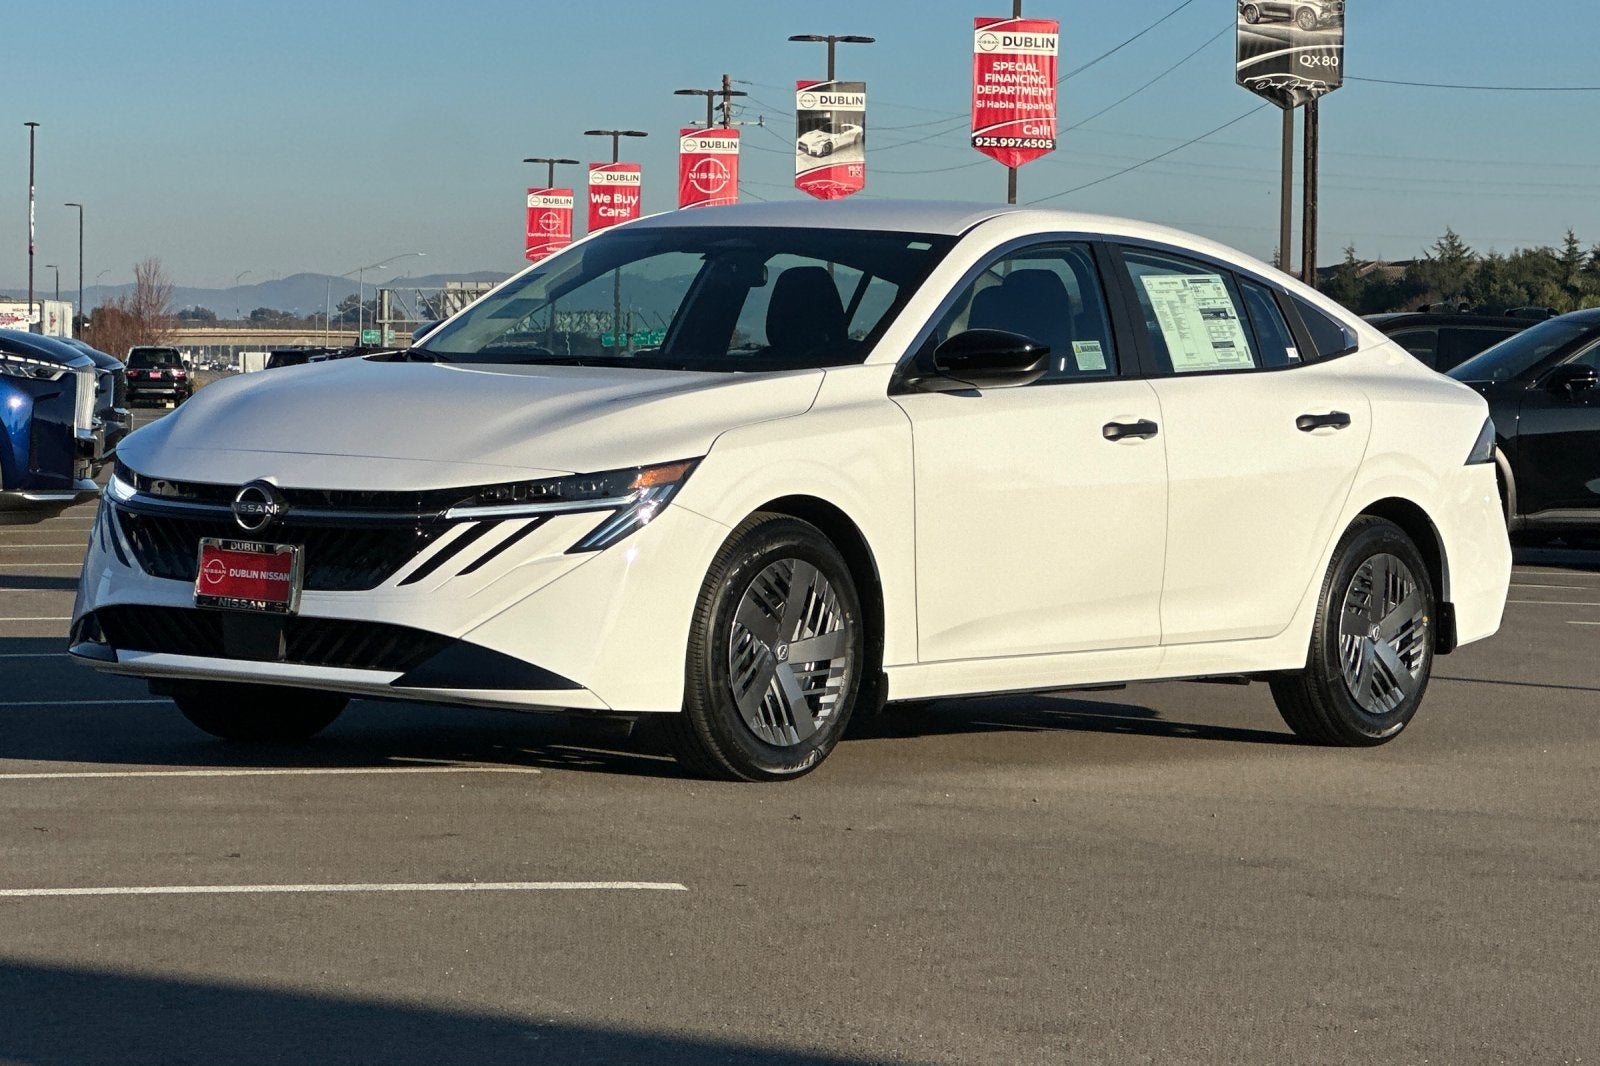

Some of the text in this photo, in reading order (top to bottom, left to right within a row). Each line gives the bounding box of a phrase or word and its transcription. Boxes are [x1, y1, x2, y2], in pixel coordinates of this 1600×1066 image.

[1003, 36, 1055, 48] DUBLIN
[993, 62, 1039, 72] SPECIAL
[1299, 55, 1339, 68] QX80
[985, 74, 1046, 84] FINANCING
[977, 86, 1053, 96] DEPARTMENT
[820, 96, 863, 105] DUBLIN
[976, 99, 985, 109] Si
[986, 100, 1015, 109] Habla
[1023, 124, 1051, 137] Call!
[975, 137, 1053, 148] 925.997.4505
[542, 197, 572, 205] DUBLIN
[590, 193, 639, 206] We Buy
[598, 206, 630, 217] Cars!
[231, 502, 274, 515] NISSAN
[230, 542, 266, 552] DUBLIN
[229, 569, 289, 581] DUBLIN NISSAN
[218, 597, 266, 610] NISSAN
